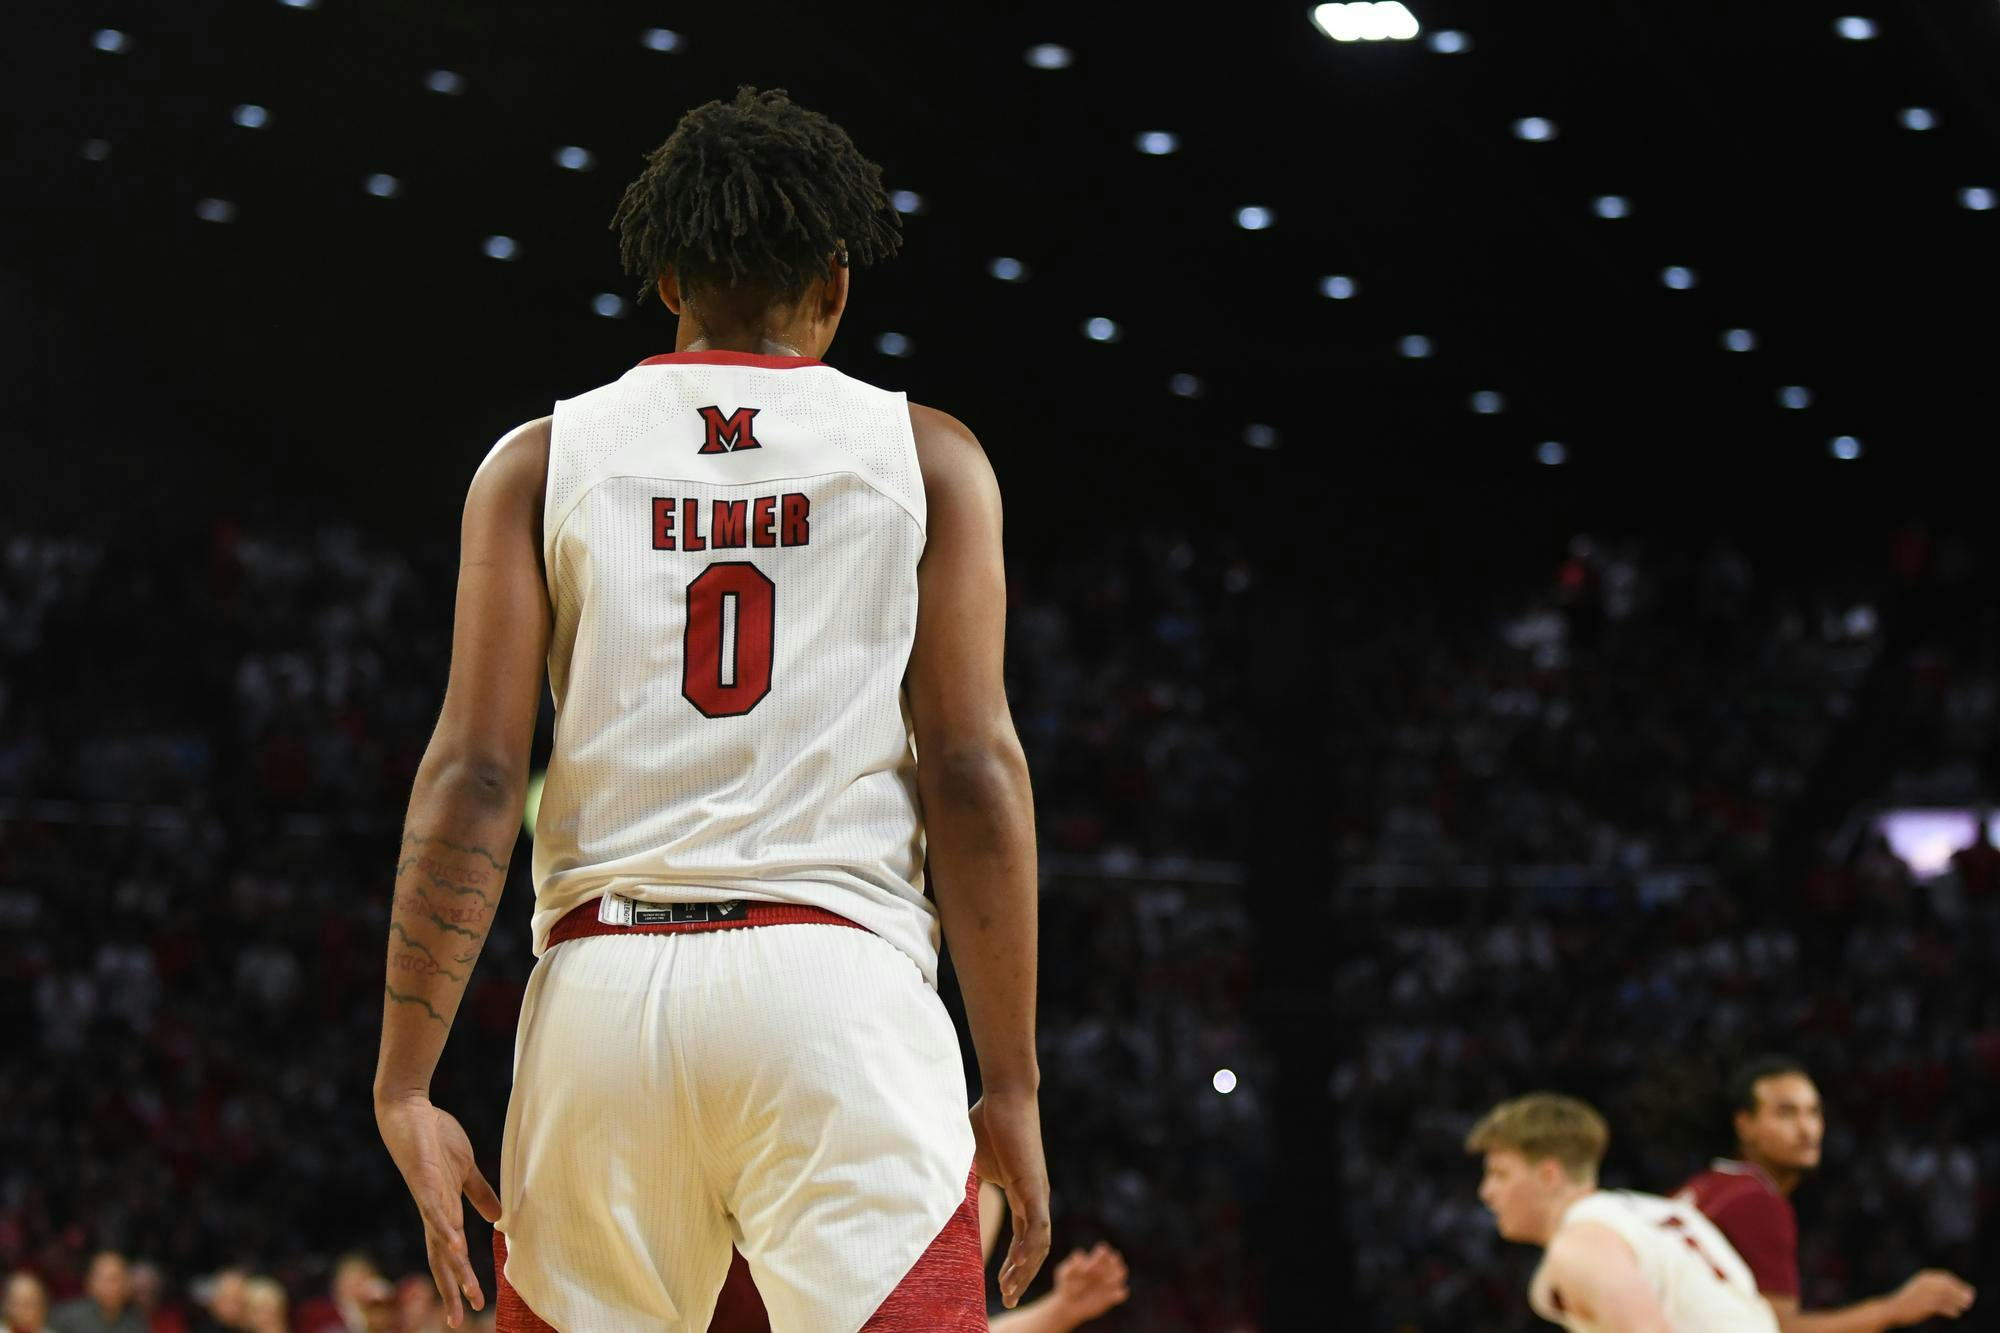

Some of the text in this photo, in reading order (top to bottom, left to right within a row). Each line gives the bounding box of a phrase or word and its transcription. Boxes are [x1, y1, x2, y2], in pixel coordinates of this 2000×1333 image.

[697, 405, 762, 454] M
[652, 492, 811, 552] ELMER
[682, 561, 776, 719] 0
